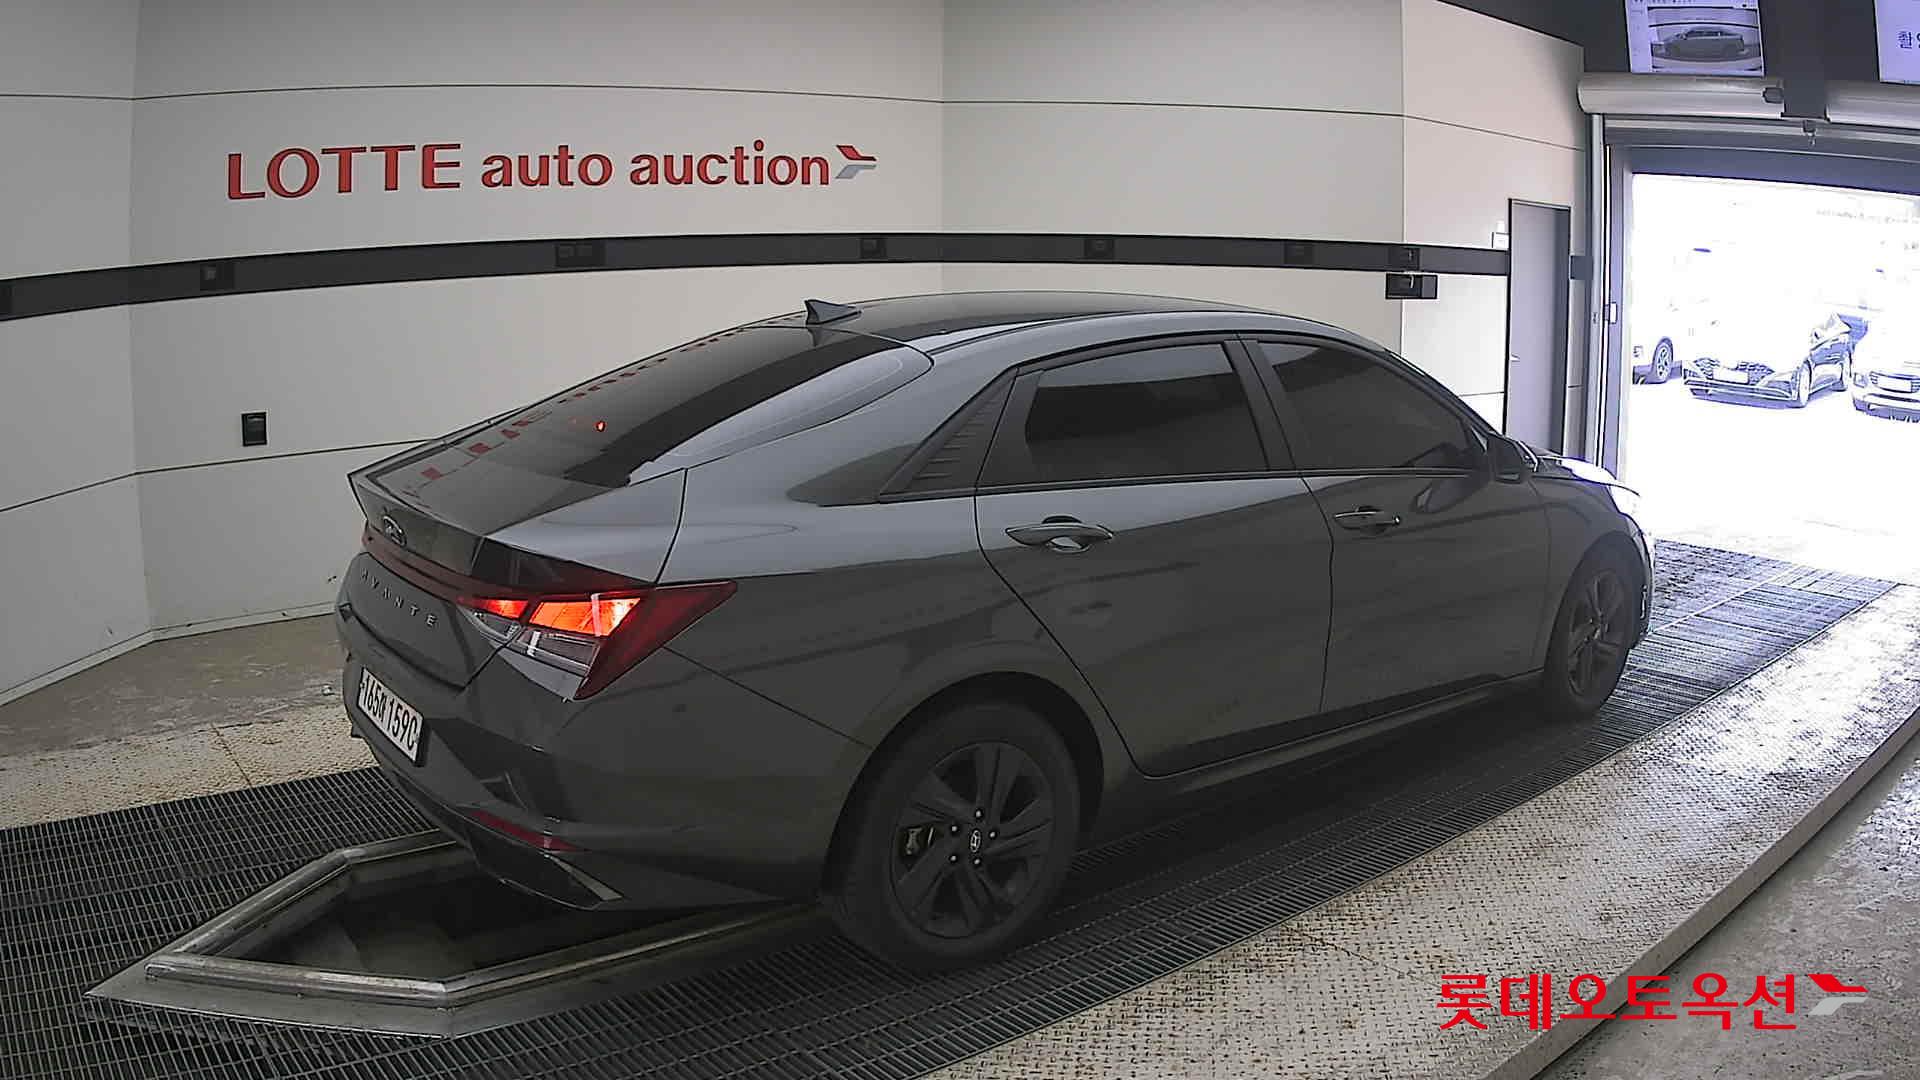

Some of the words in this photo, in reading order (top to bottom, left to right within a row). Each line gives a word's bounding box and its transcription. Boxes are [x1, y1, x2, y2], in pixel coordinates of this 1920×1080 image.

[227, 143, 461, 200] LOTTE
[481, 144, 613, 189] auto
[629, 140, 830, 187] auction
[360, 567, 437, 627] AVANTE
